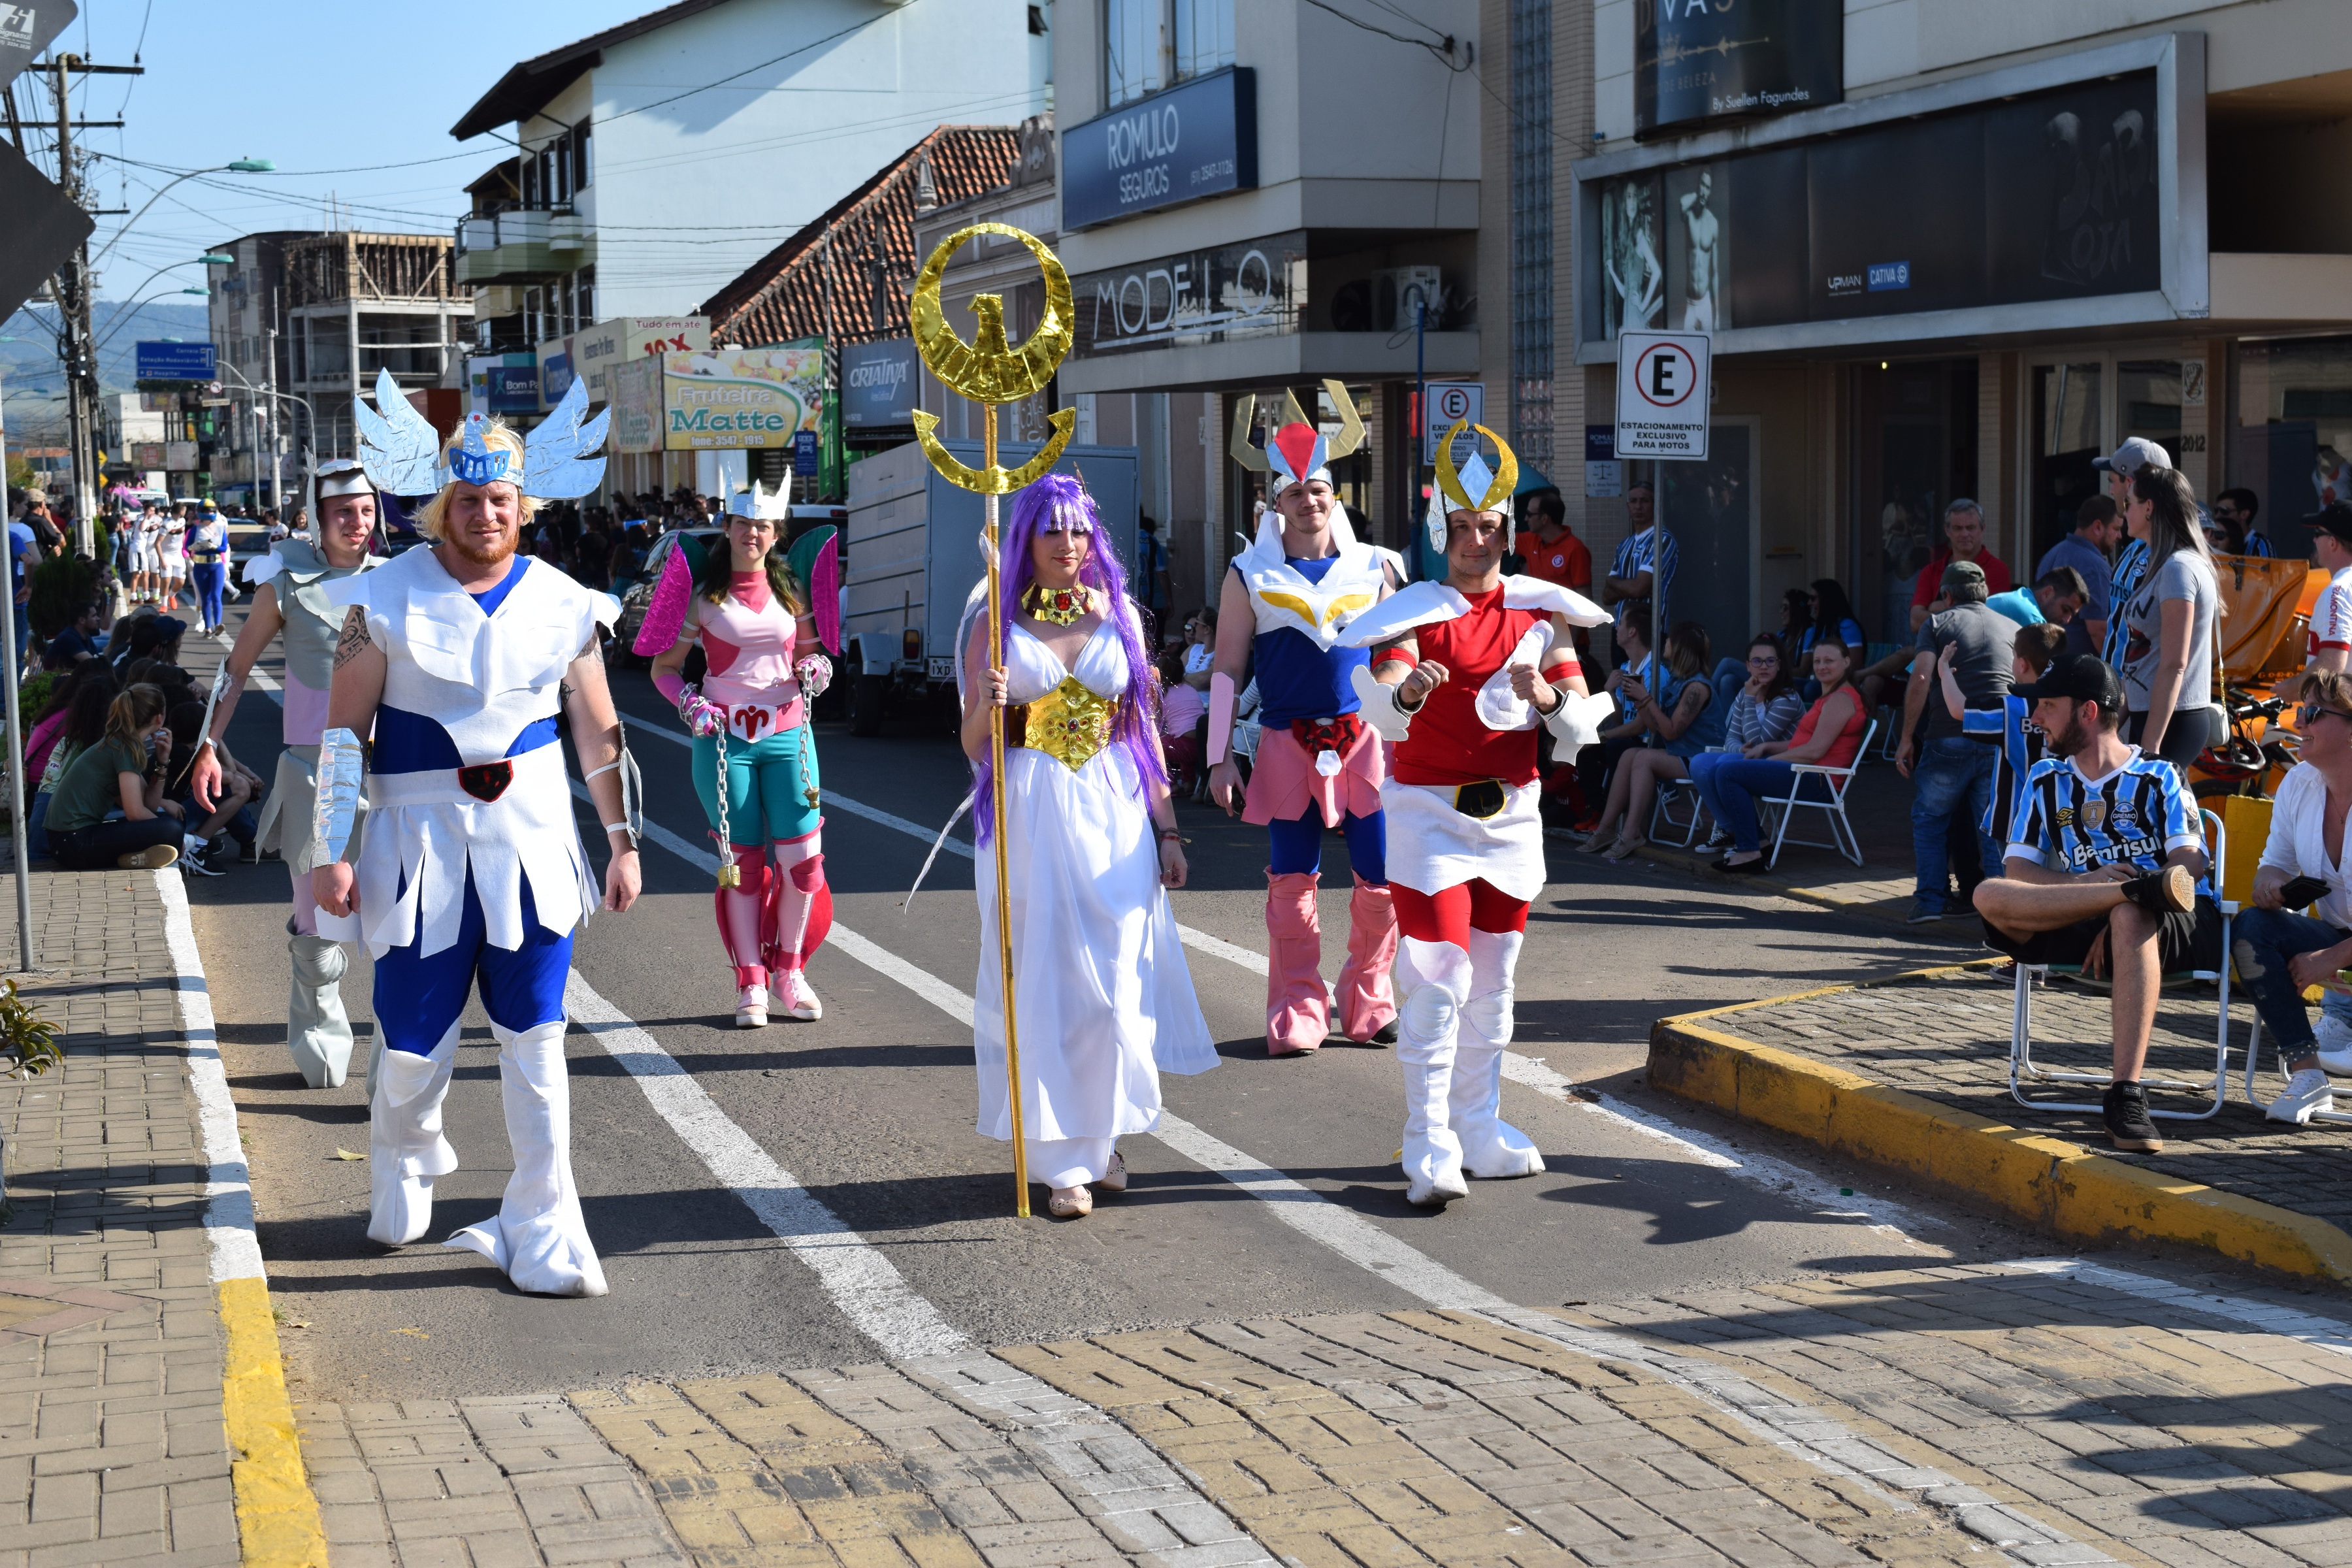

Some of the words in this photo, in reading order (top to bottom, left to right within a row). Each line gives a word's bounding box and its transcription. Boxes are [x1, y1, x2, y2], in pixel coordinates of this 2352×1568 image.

[1677, 72, 1716, 90] BELEZA
[1713, 97, 1723, 112] By
[1725, 93, 1757, 108] Suellen
[1761, 86, 1810, 106] Fagundes
[1107, 104, 1179, 171] ROMULO
[1119, 164, 1169, 204] SEGUROS
[1827, 274, 1861, 290] UPMAN
[1870, 267, 1895, 285] CATIVA
[1093, 250, 1271, 340] MODELO
[506, 380, 527, 390] Bom
[849, 358, 909, 401] CRIATIVA
[1652, 355, 1675, 397] E
[678, 386, 776, 405] Fruteira
[1450, 395, 1460, 413] E
[669, 408, 785, 433] Matte
[1621, 422, 1703, 431] ESTACIONAMENTO
[691, 435, 714, 447] fone:
[715, 435, 737, 446] 3547
[743, 434, 764, 446] 1915
[1637, 432, 1686, 440] EXCLUSIVO
[2181, 434, 2206, 452] 2012
[2328, 584, 2342, 636] TRAMONTINA
[2074, 837, 2163, 867] Banrisul
